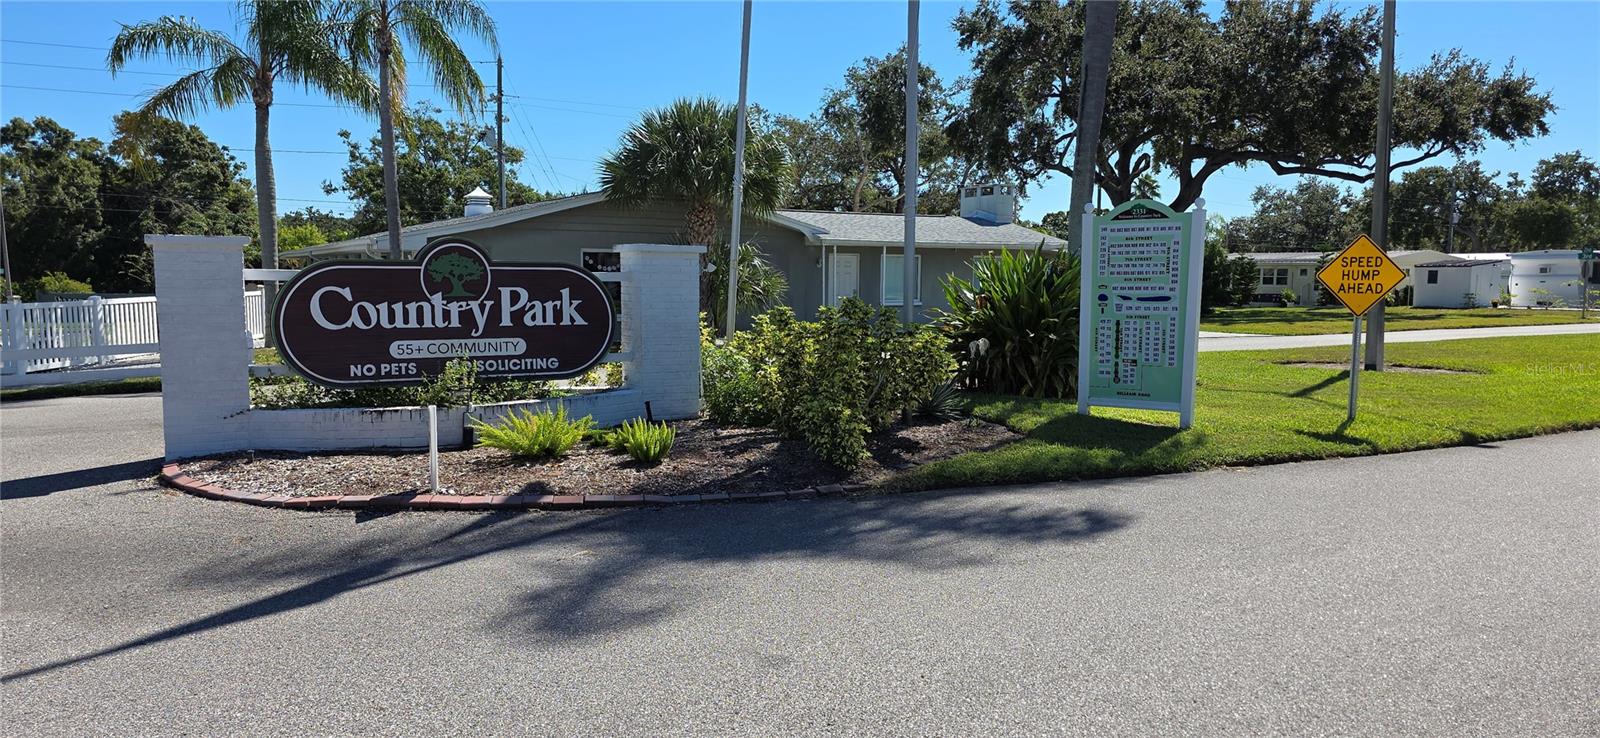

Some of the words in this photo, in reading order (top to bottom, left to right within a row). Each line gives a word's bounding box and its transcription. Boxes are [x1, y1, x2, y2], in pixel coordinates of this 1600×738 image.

[1341, 256, 1383, 268] SPEED
[1341, 269, 1380, 281] HUMP
[1337, 283, 1383, 294] AHEAD
[309, 285, 494, 337] Country
[498, 286, 588, 327] Park
[396, 343, 424, 356] 55+
[426, 341, 521, 355] COMMUNITY
[350, 364, 376, 377] NO
[380, 363, 417, 376] PETS
[477, 357, 559, 372] SOLICITING
